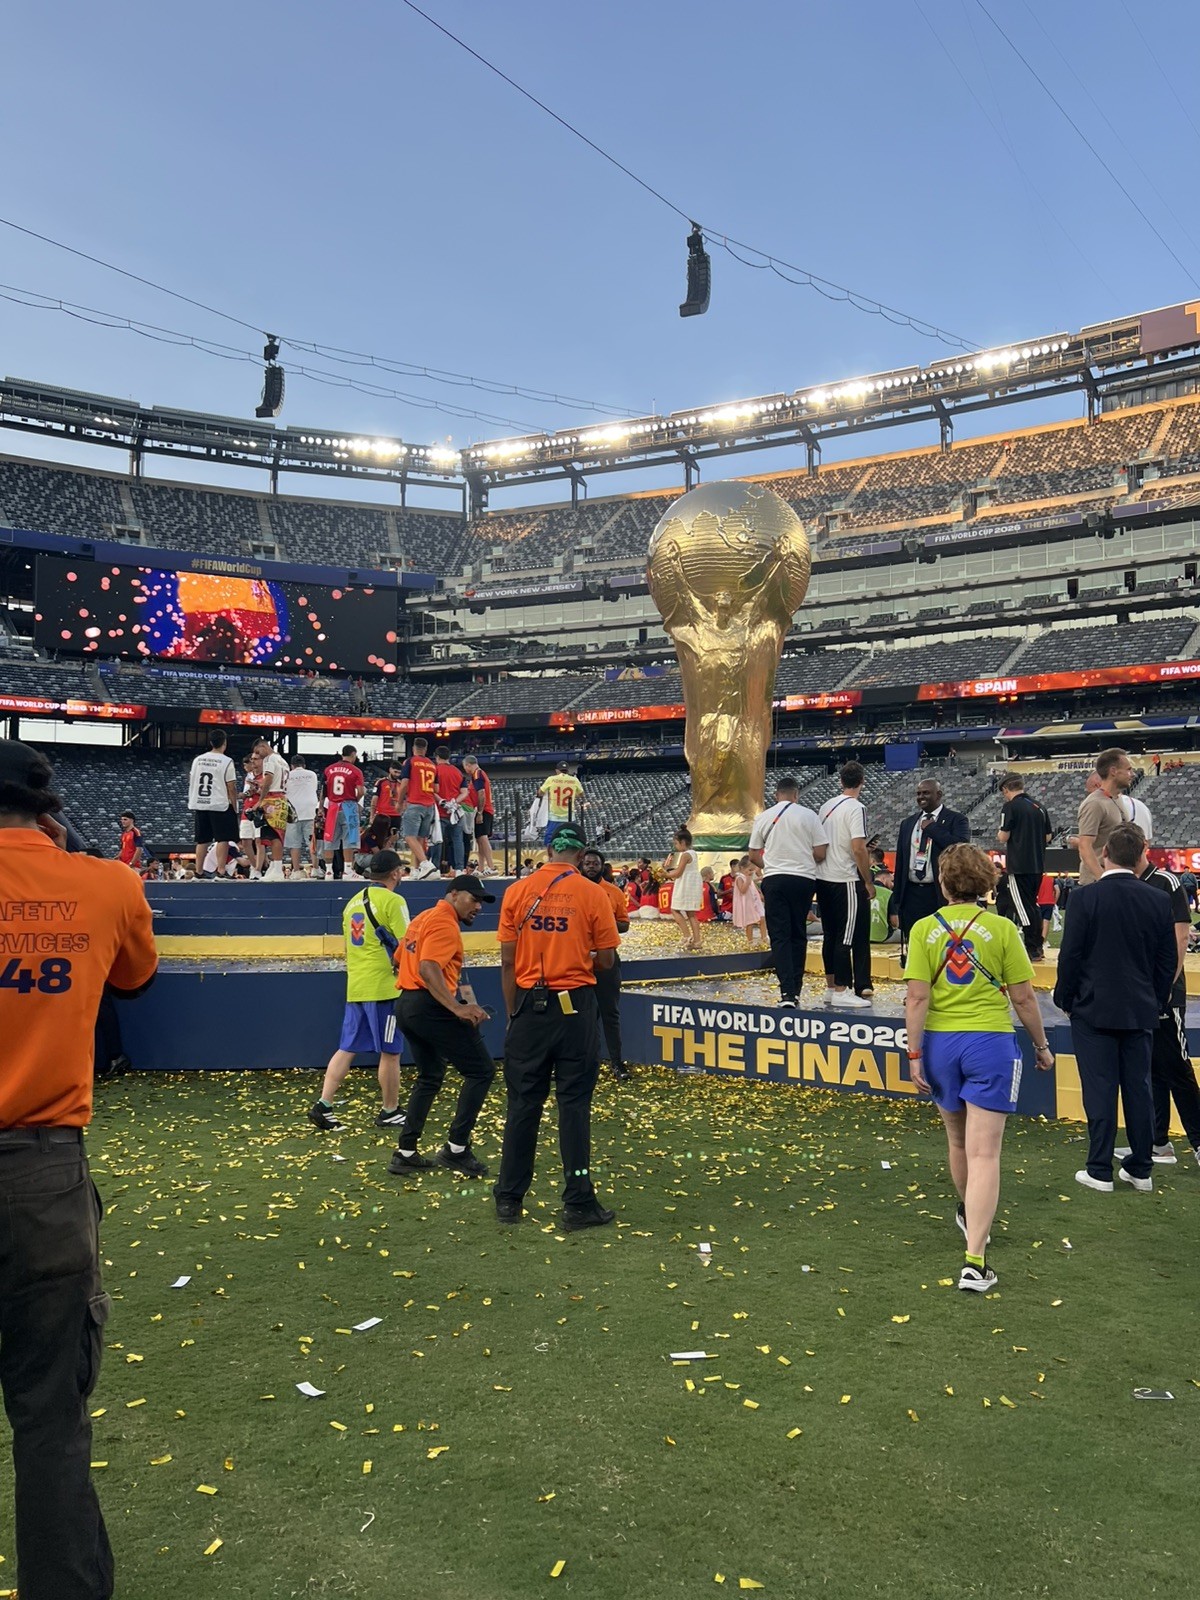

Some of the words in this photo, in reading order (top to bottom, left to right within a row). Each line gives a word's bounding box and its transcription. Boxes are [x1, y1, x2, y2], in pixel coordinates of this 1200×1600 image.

[934, 535, 950, 543] FIFA
[951, 530, 978, 540] WORLD
[978, 528, 994, 536] CUP
[994, 524, 1021, 534] 2026
[1024, 522, 1042, 530] THE
[1043, 517, 1071, 527] FINAL
[191, 558, 262, 576] #FIFAWorldCup
[474, 591, 493, 599] NEW
[495, 589, 518, 597] YORK
[520, 586, 540, 594] NEW
[541, 583, 577, 592] JERSEY
[162, 670, 178, 678] FIFA
[1161, 666, 1181, 676] FIFA
[974, 680, 1017, 693] SPAIN
[15, 700, 44, 709] WORLD
[825, 695, 850, 703] FINAL
[250, 714, 286, 725] SPAIN
[332, 775, 346, 796] 6
[420, 768, 435, 792] 12
[553, 786, 573, 806] 12
[530, 915, 569, 932] 363
[652, 1003, 696, 1026] FIFA
[697, 1008, 776, 1034] WORLD
[779, 1017, 826, 1039] CUP
[829, 1021, 909, 1050] 2026
[653, 1025, 746, 1072] THE
[756, 1037, 919, 1095] FINAL
